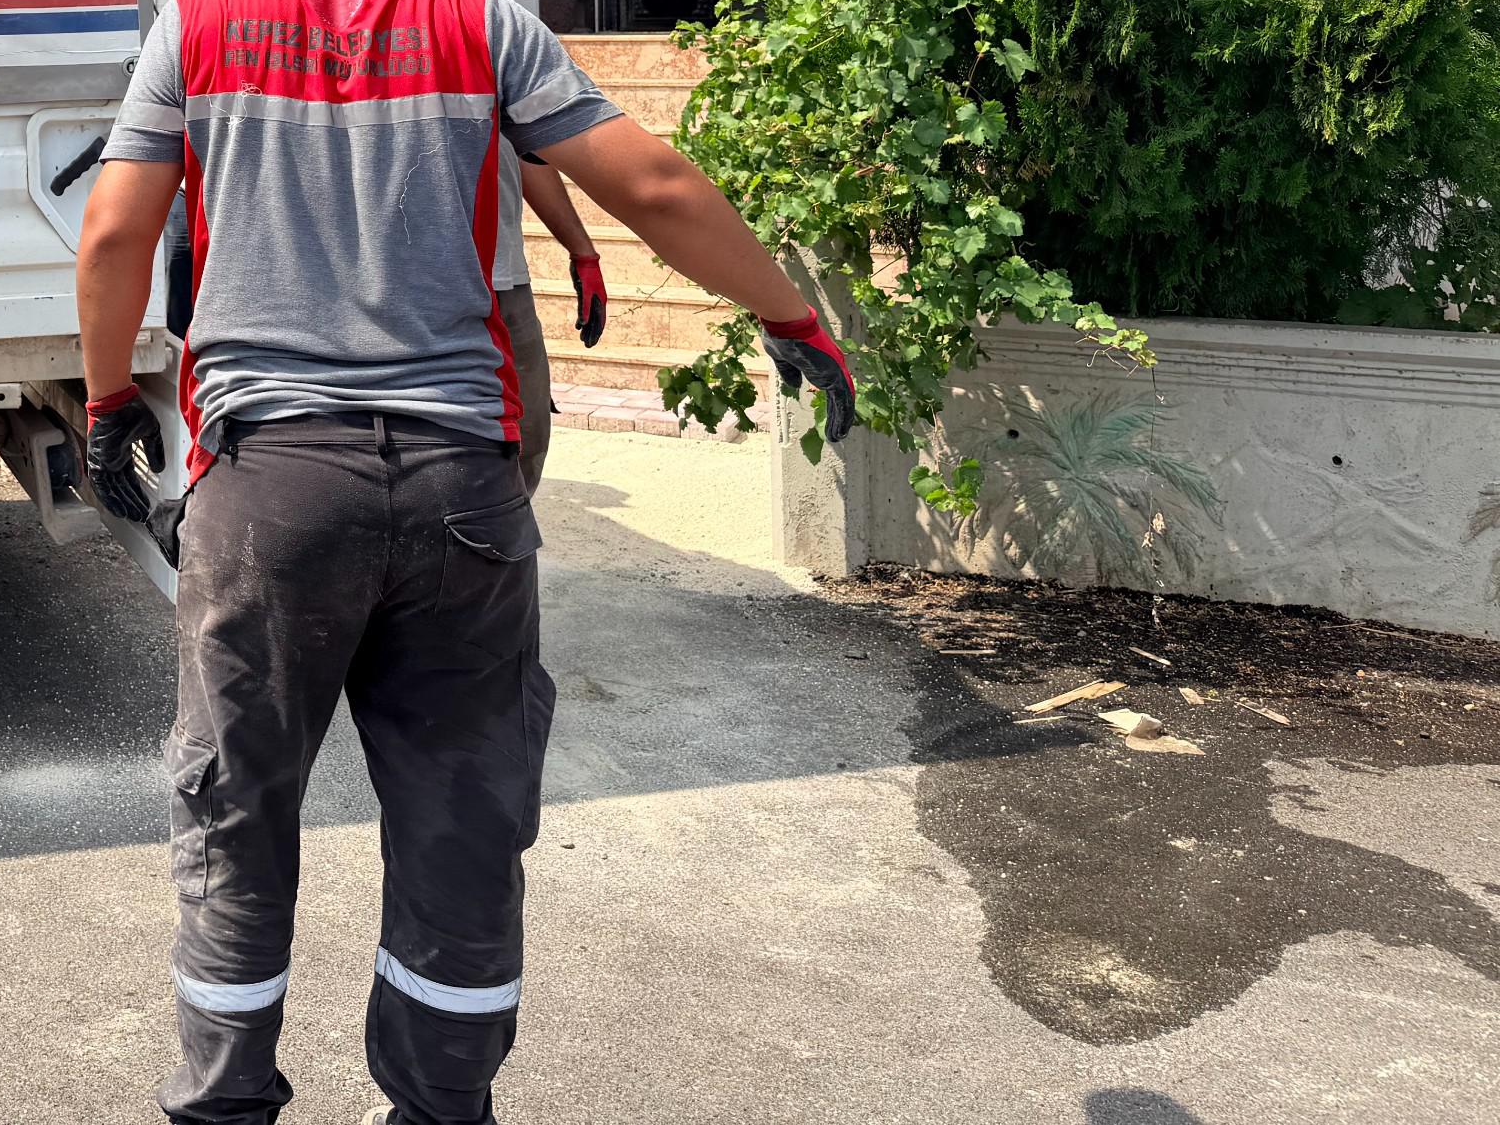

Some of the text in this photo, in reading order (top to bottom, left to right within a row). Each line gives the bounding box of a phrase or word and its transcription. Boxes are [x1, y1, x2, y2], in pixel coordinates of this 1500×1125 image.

[226, 19, 430, 56] KEPEZ BELEDYESİ
[323, 52, 431, 80] MÜÜRLÜĞÜ
